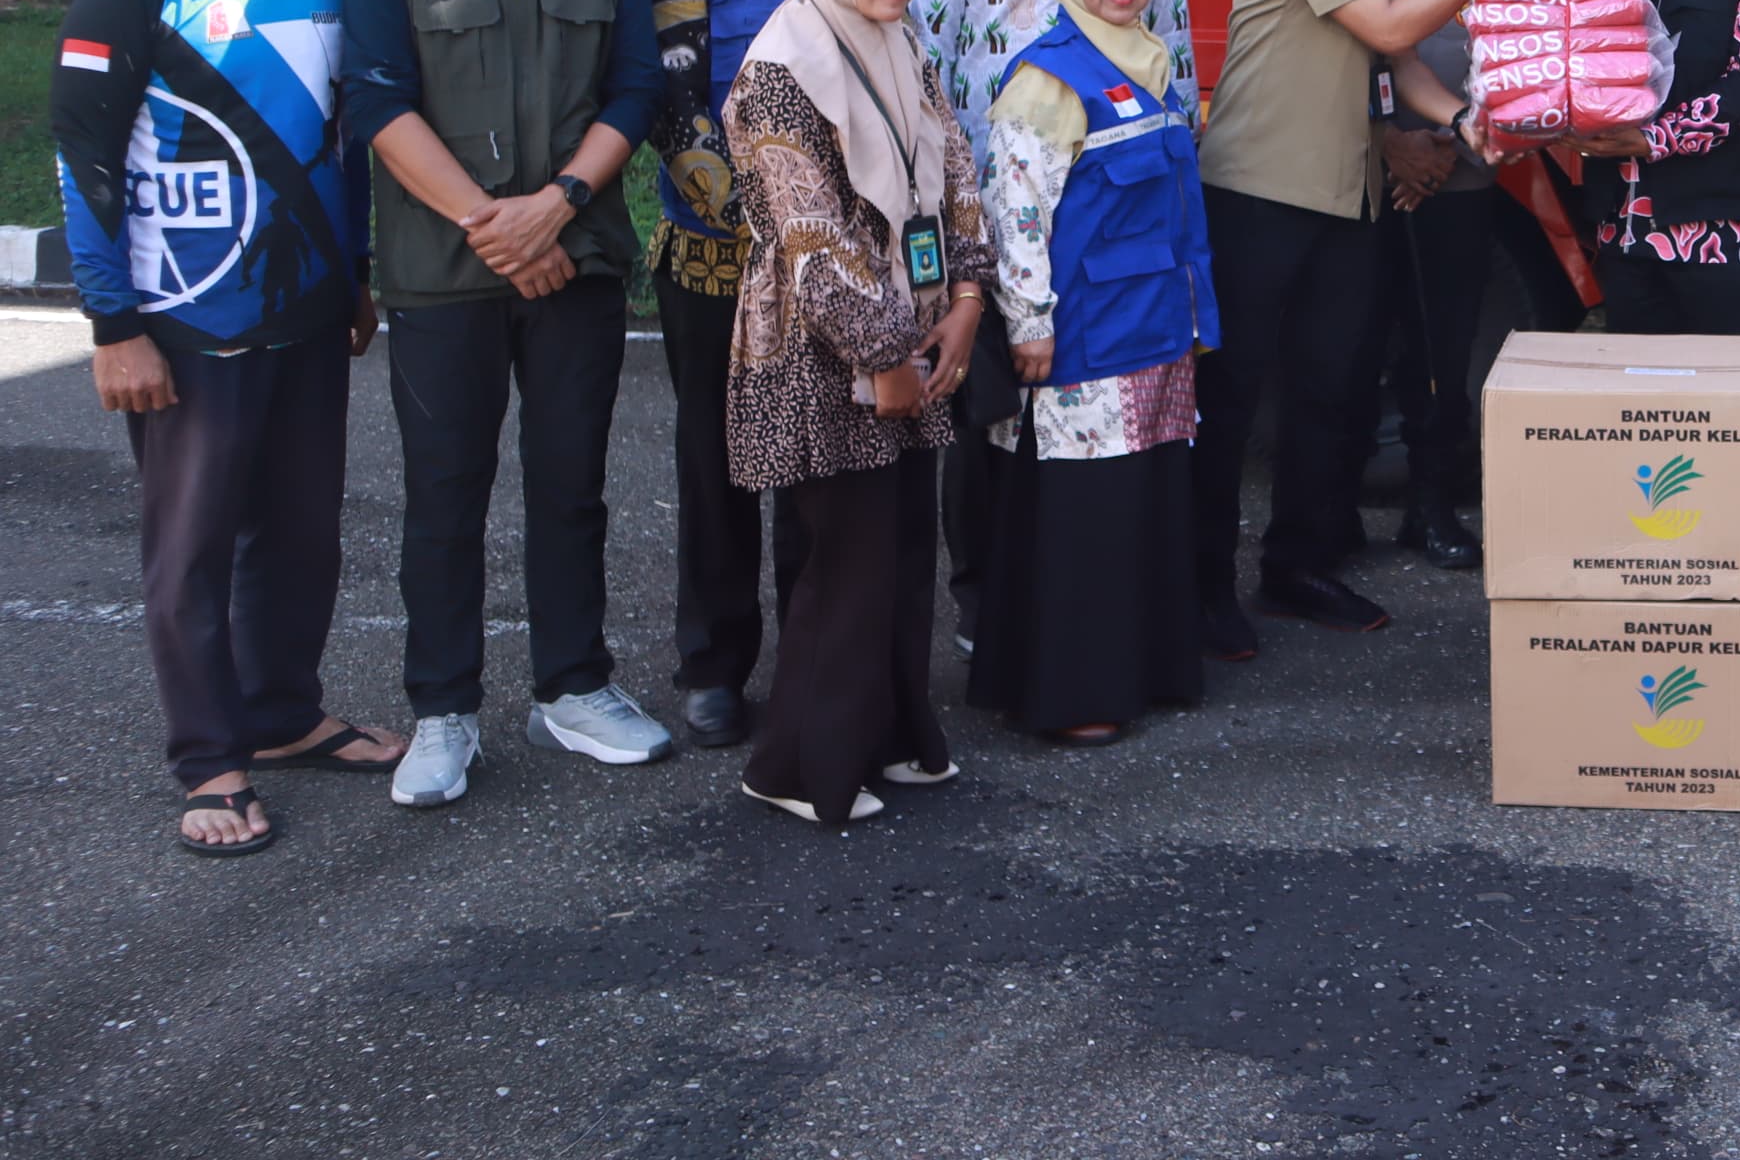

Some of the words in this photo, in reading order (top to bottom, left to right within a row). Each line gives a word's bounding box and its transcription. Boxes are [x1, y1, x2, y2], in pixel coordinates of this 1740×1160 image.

[1621, 410, 1710, 423] BANTUAN
[1525, 428, 1632, 441] PERALATAN
[1639, 429, 1701, 442] DAPUR
[1573, 559, 1681, 569] KEMENTERIAN
[1686, 559, 1739, 570] SOSIAL
[1621, 574, 1672, 585] TAHUN
[1677, 574, 1711, 585] 2023
[1624, 622, 1712, 636] BANTUAN
[1530, 637, 1635, 652] PERALATAN
[1642, 641, 1703, 654] DAPUR
[1578, 766, 1685, 778] KEMENTERIAN
[1625, 782, 1676, 793] TAHUN
[1681, 783, 1715, 794] 2023
